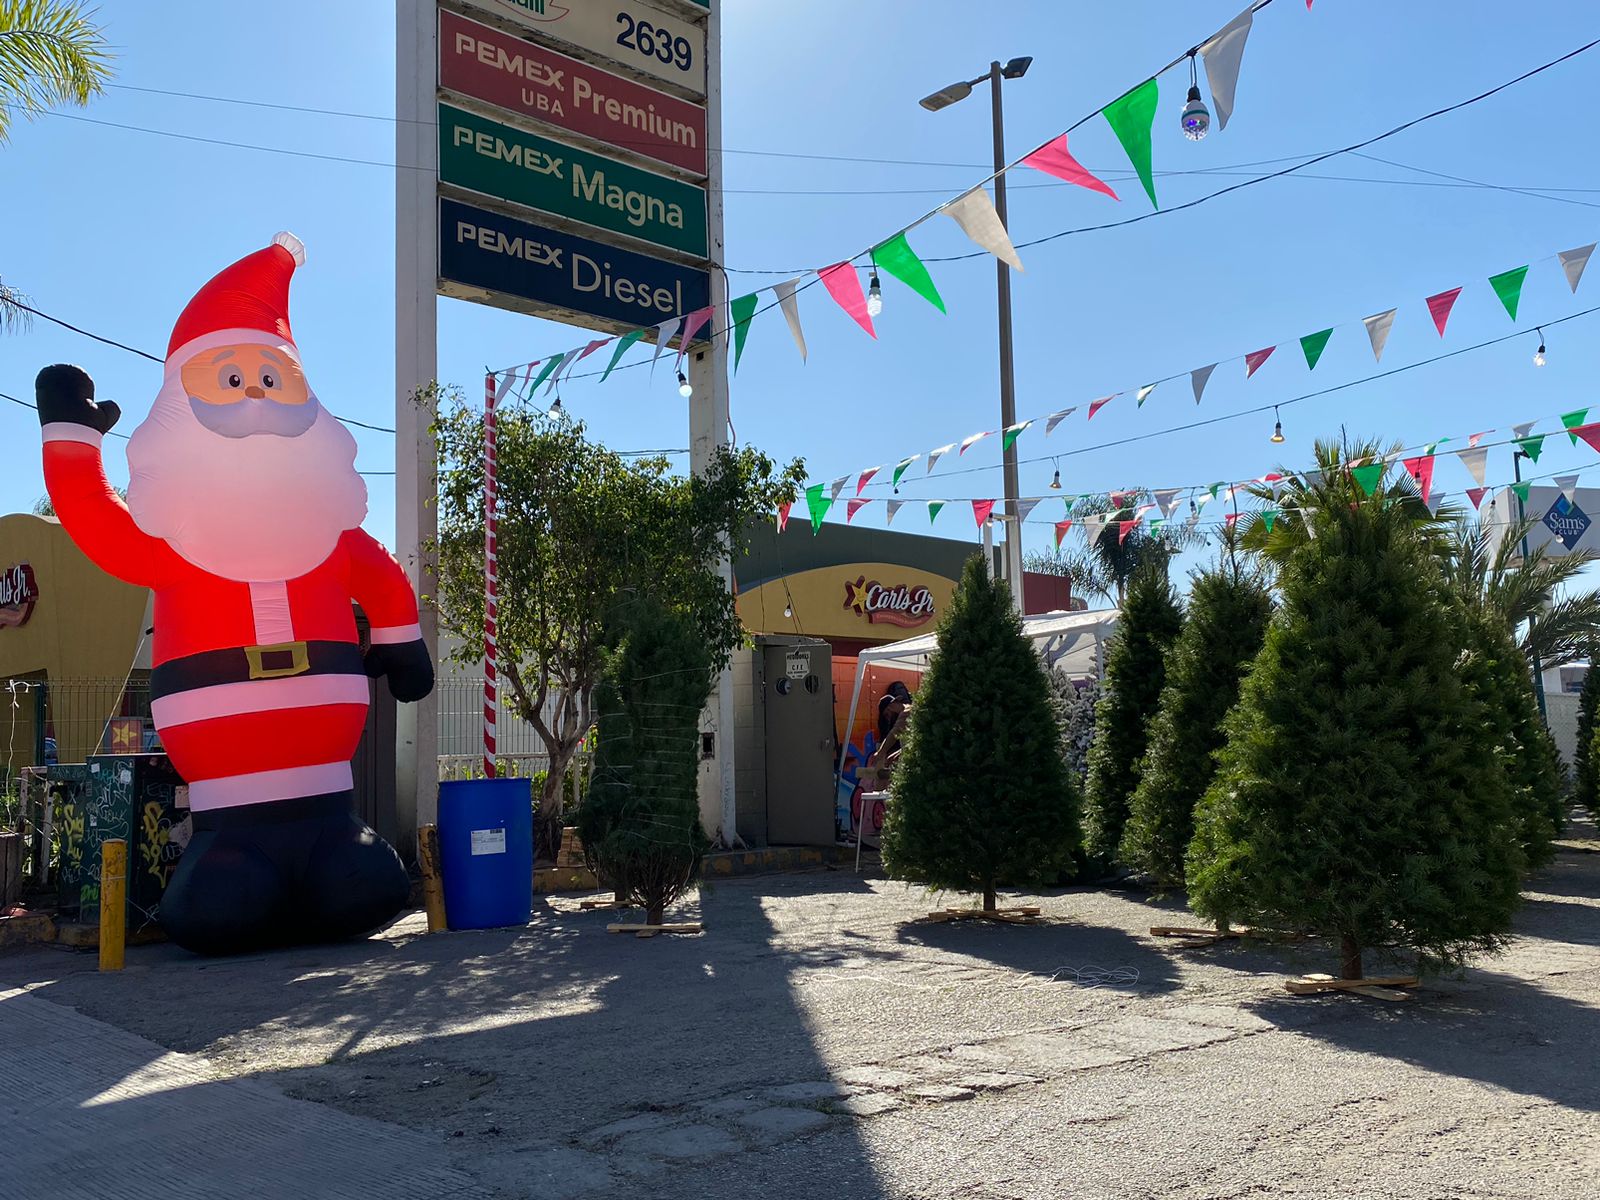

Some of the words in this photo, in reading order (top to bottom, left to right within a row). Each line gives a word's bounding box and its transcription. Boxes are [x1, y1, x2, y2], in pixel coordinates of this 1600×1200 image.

[616, 12, 693, 72] 2639
[455, 32, 564, 91] PEMEX
[573, 76, 697, 149] Premium
[521, 88, 565, 118] UBA
[454, 125, 564, 180] PEMEX
[572, 163, 684, 229] Magna
[457, 221, 563, 270] PEMEX
[572, 252, 682, 316] Diesel
[1549, 512, 1585, 530] Sam's
[865, 584, 911, 611] Carl's
